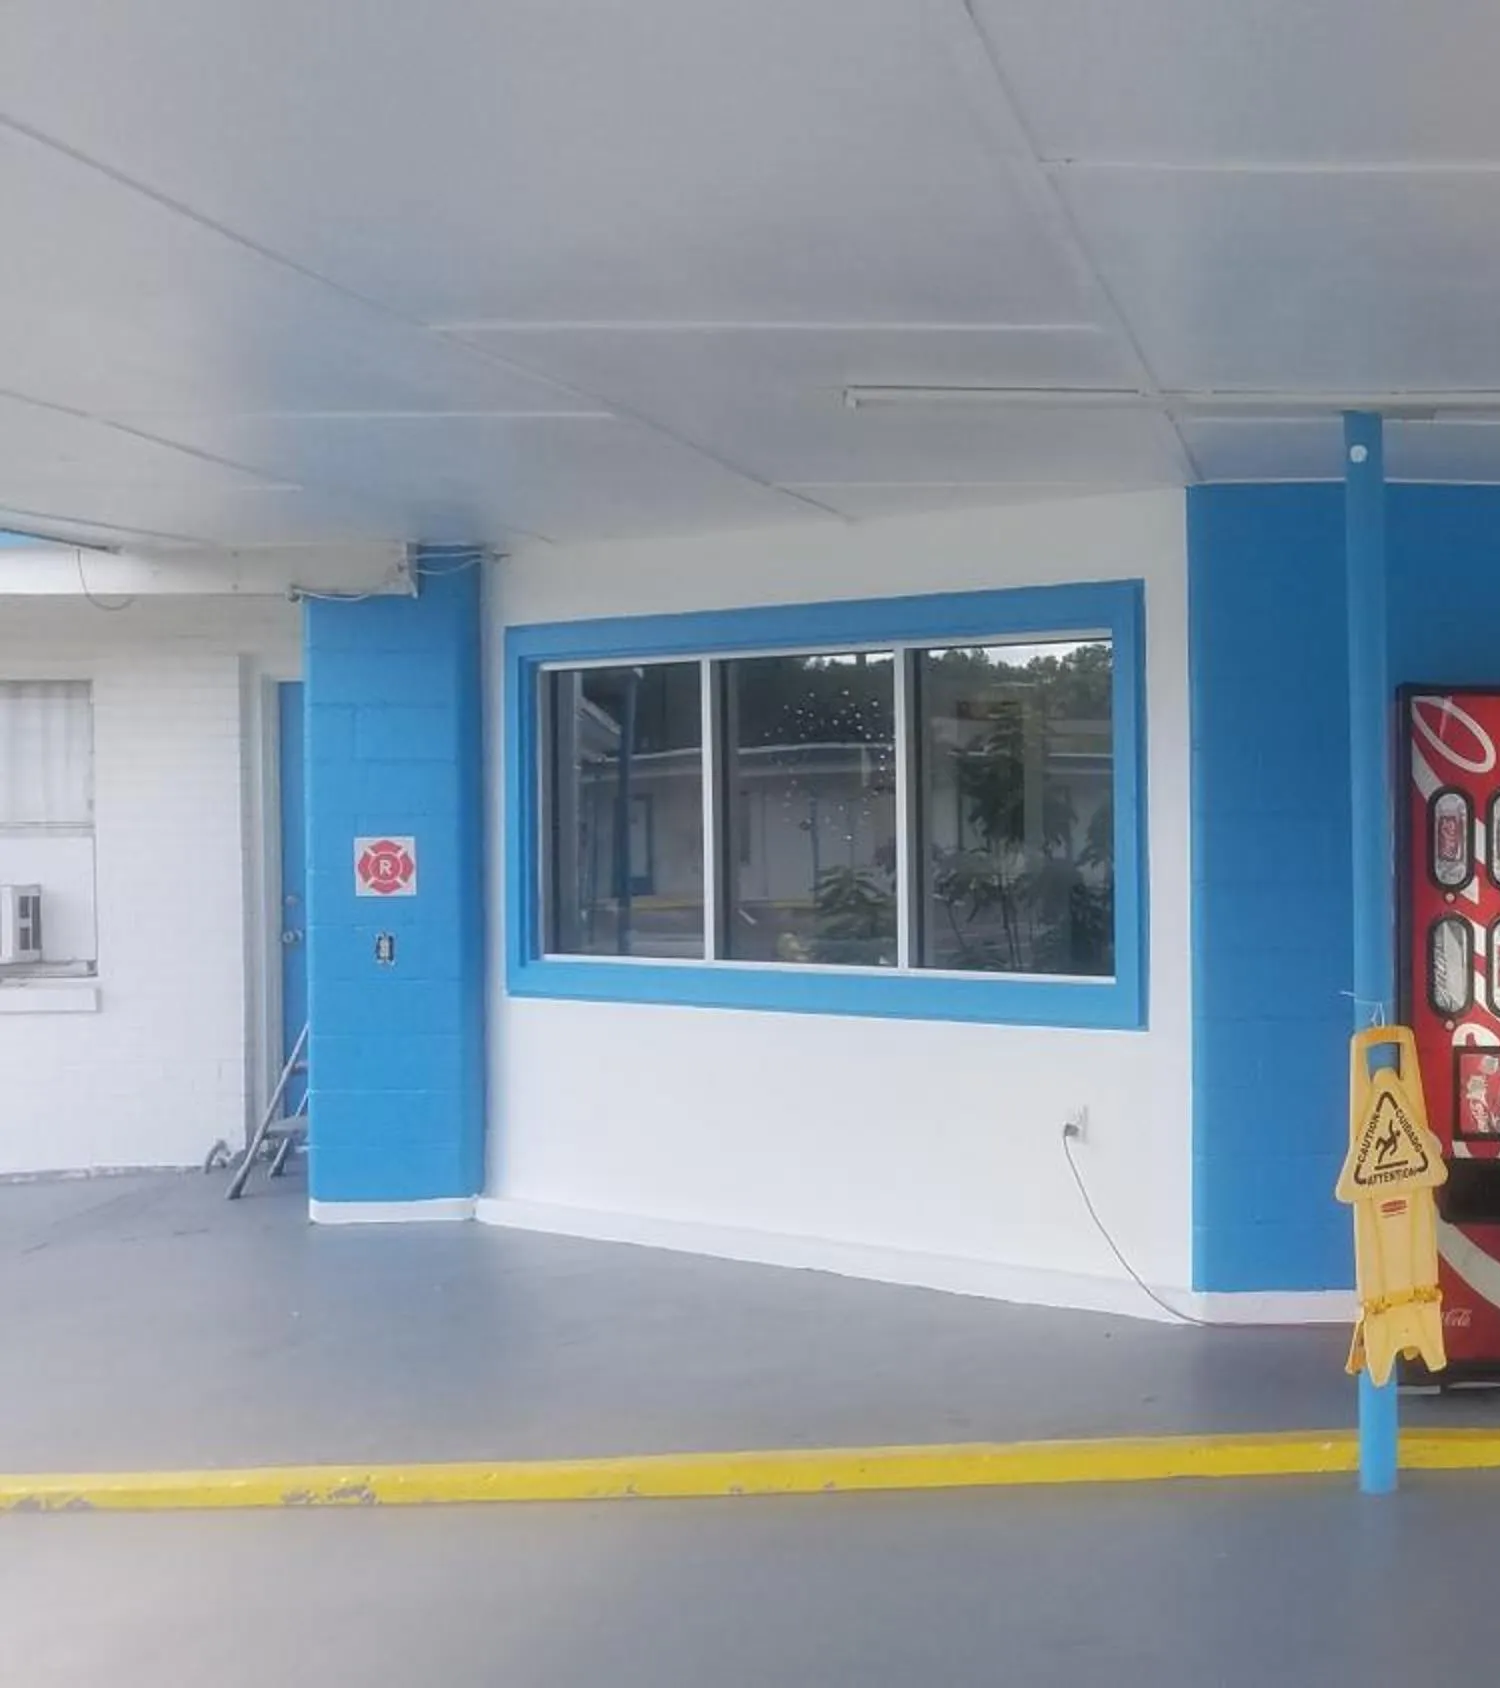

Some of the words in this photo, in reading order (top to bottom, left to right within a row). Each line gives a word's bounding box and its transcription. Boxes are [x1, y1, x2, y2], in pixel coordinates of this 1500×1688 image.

[379, 859, 392, 876] R
[1357, 1112, 1381, 1164] CAUTION
[1394, 1107, 1423, 1153] CUIDADO
